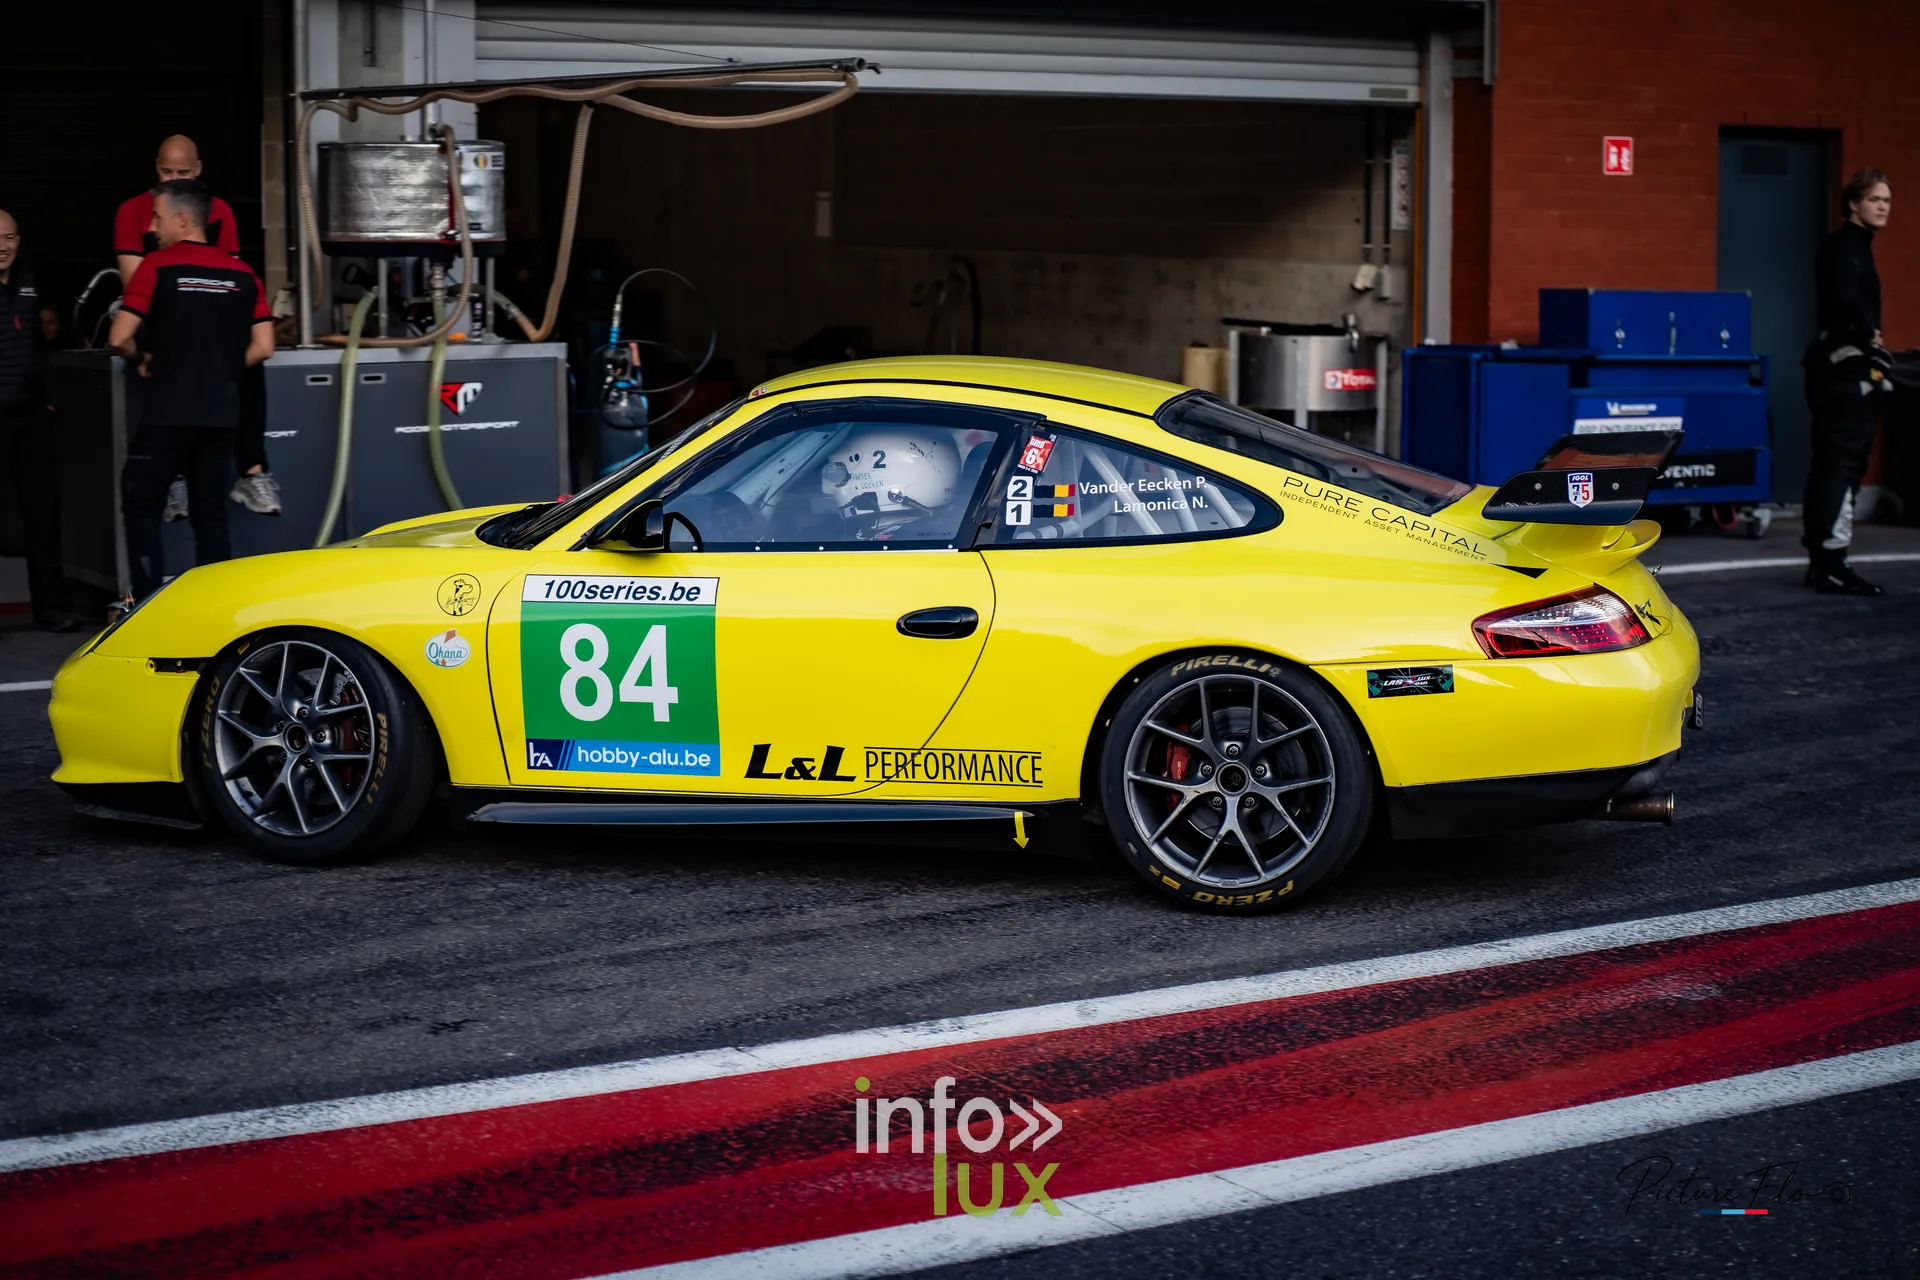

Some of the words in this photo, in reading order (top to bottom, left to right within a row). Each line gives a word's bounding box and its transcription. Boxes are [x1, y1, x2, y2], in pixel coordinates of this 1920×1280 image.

[872, 449, 887, 469] 2
[1025, 447, 1039, 465] 6
[1011, 479, 1028, 498] 2
[1079, 479, 1134, 495] Vander
[1138, 477, 1192, 492] Eecken
[1196, 476, 1207, 488] P.
[1010, 503, 1023, 523] 1
[1114, 497, 1188, 513] Lamonica
[1192, 496, 1208, 509] N.
[1279, 490, 1358, 520] INDEPENDENT
[1364, 518, 1401, 535] ASSET
[1405, 532, 1486, 562] MANAGEMENT
[1283, 476, 1363, 512] PURE
[1371, 507, 1487, 556] CAPITAL
[544, 579, 701, 602] 100series.be
[428, 642, 463, 659] Ohana
[559, 623, 679, 722] 84
[1170, 655, 1272, 677] PIRELLI
[367, 712, 389, 805] PIRELLI
[577, 745, 711, 768] hobby-alu.be
[743, 743, 857, 782] L&L
[864, 750, 1044, 784] PERFORMANCE
